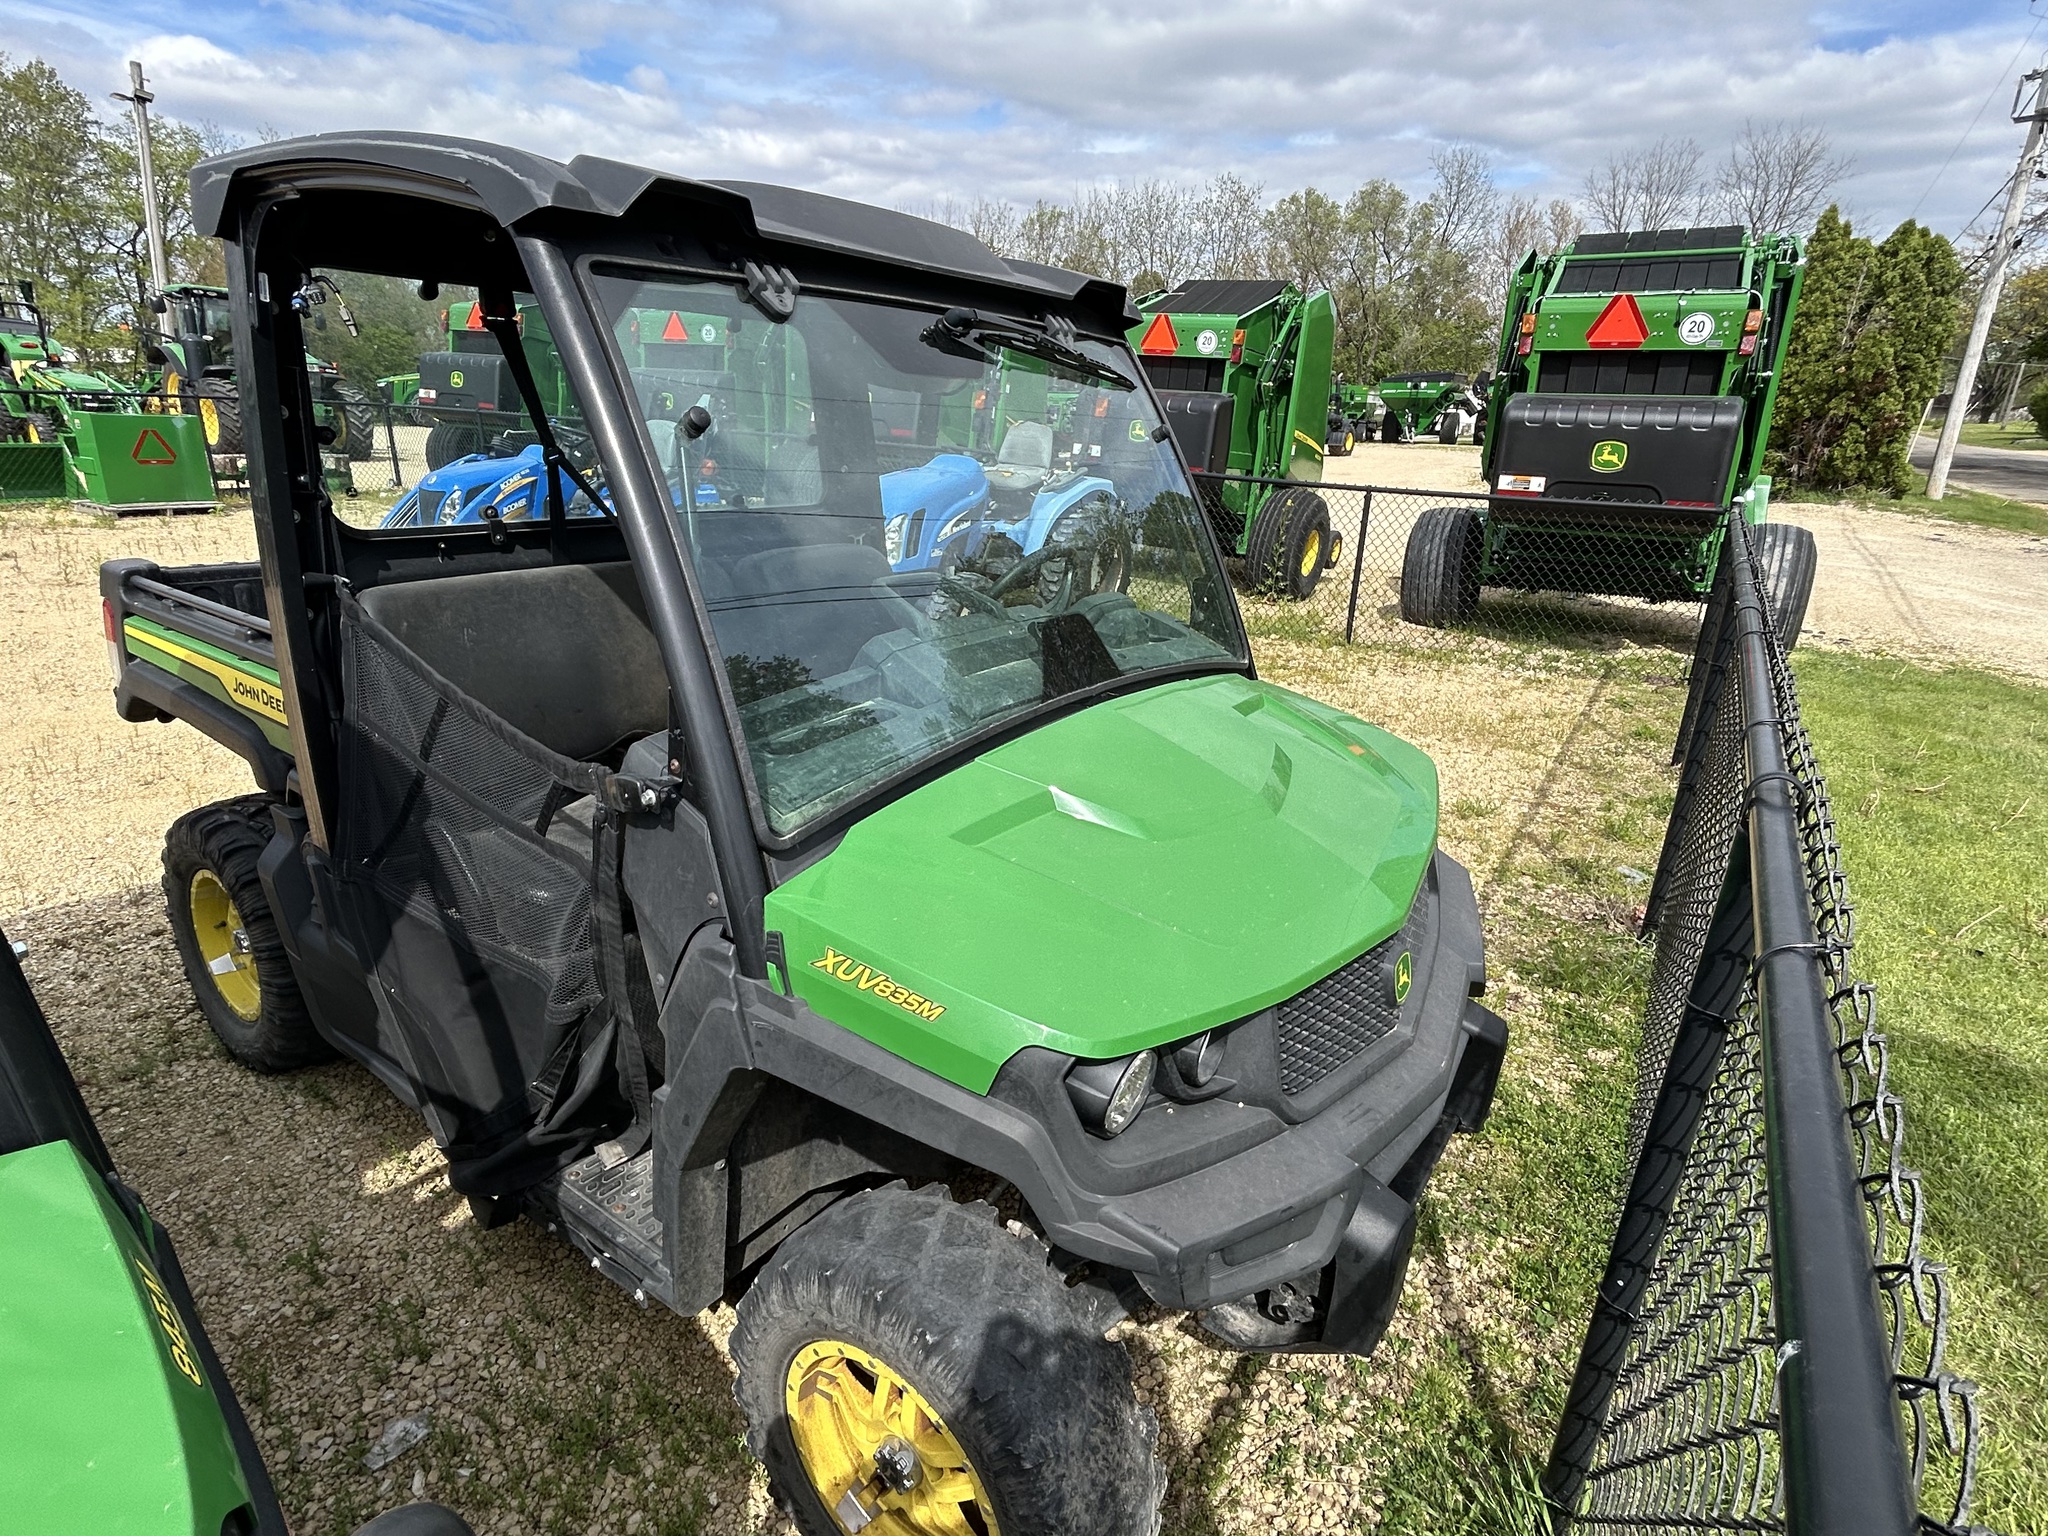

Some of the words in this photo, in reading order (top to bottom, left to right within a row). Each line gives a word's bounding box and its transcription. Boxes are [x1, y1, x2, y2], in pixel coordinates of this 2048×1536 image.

[1689, 320, 1705, 333] 20
[1202, 336, 1212, 345] 20
[503, 498, 527, 515] BOOMER
[233, 677, 260, 703] JOHN
[810, 947, 947, 1022] XUV835M
[135, 1258, 202, 1387] 845M
